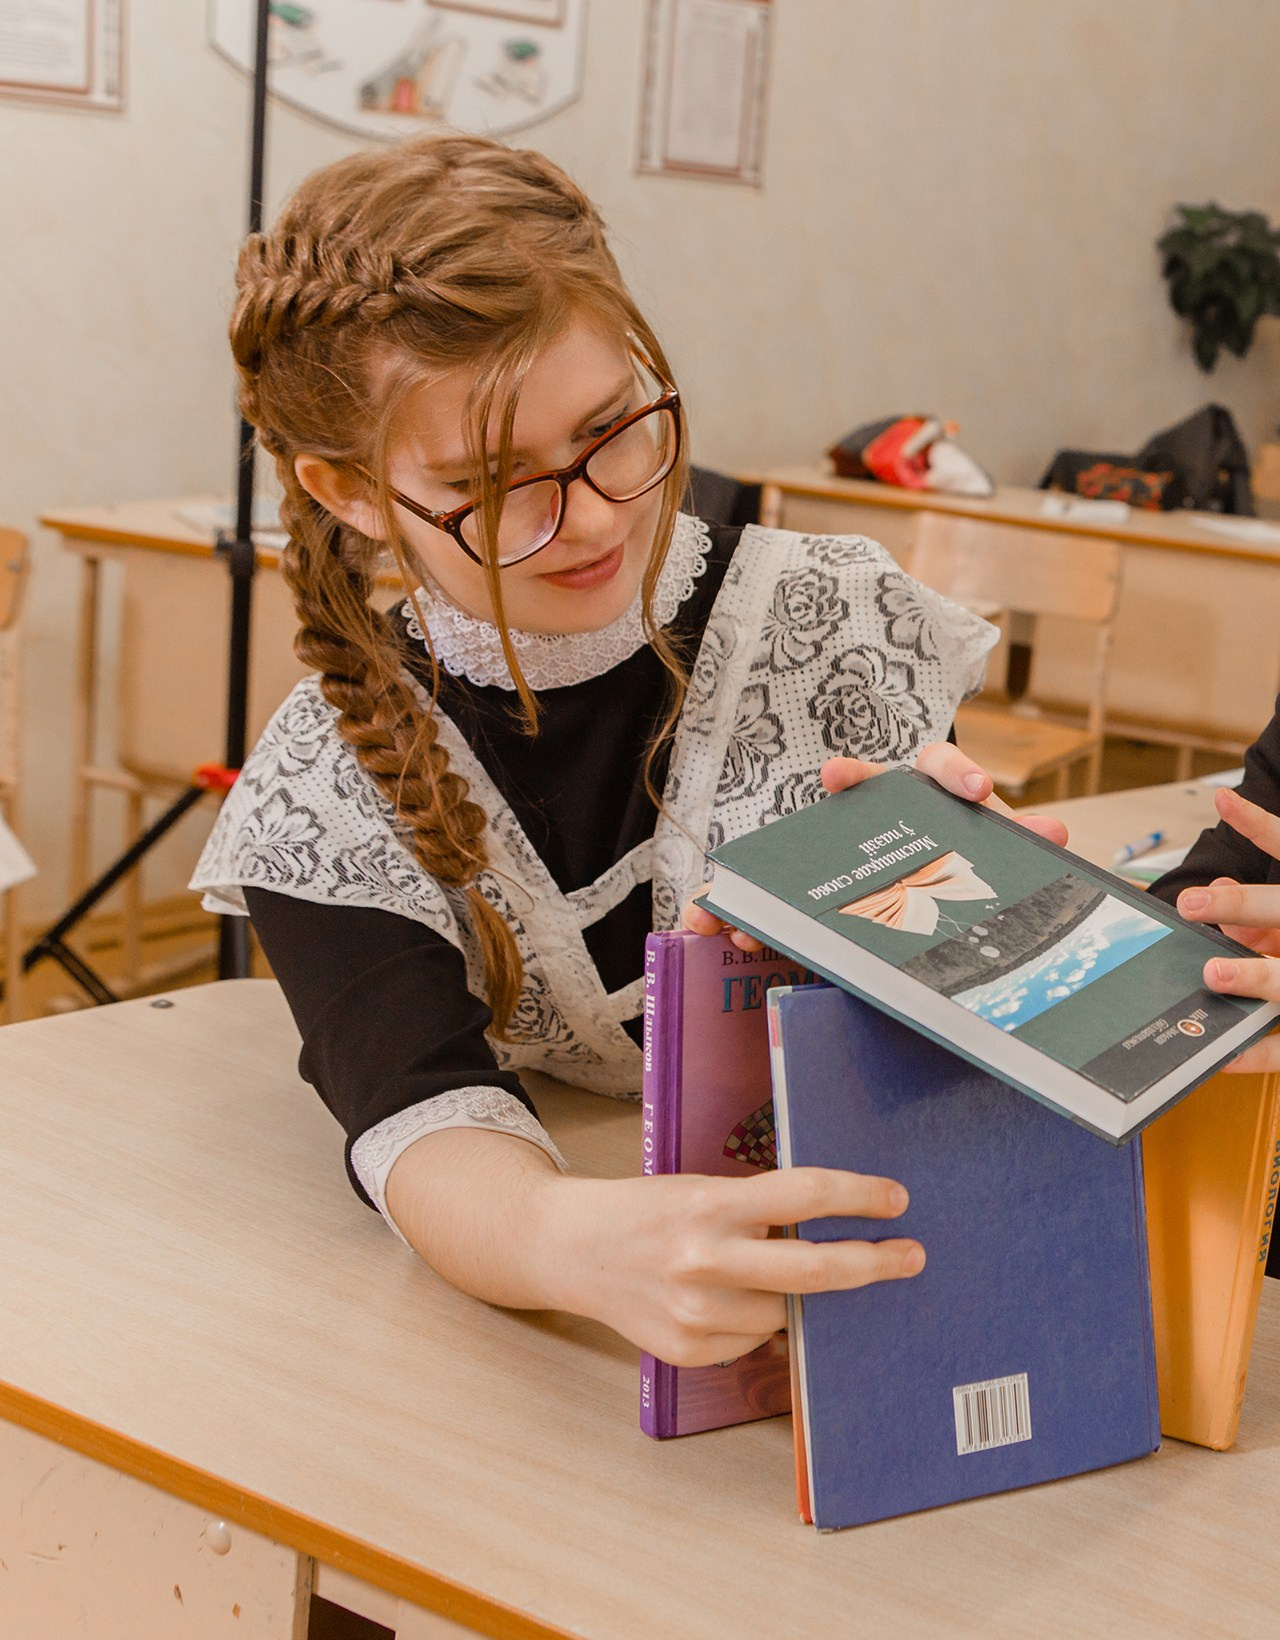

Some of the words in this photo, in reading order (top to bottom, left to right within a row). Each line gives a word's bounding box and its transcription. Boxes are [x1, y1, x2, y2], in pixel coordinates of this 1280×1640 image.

[850, 834, 939, 881] Мастацкае
[858, 828, 902, 857] паэзіі
[807, 874, 853, 902] слова
[644, 993, 656, 1072] Шлыков
